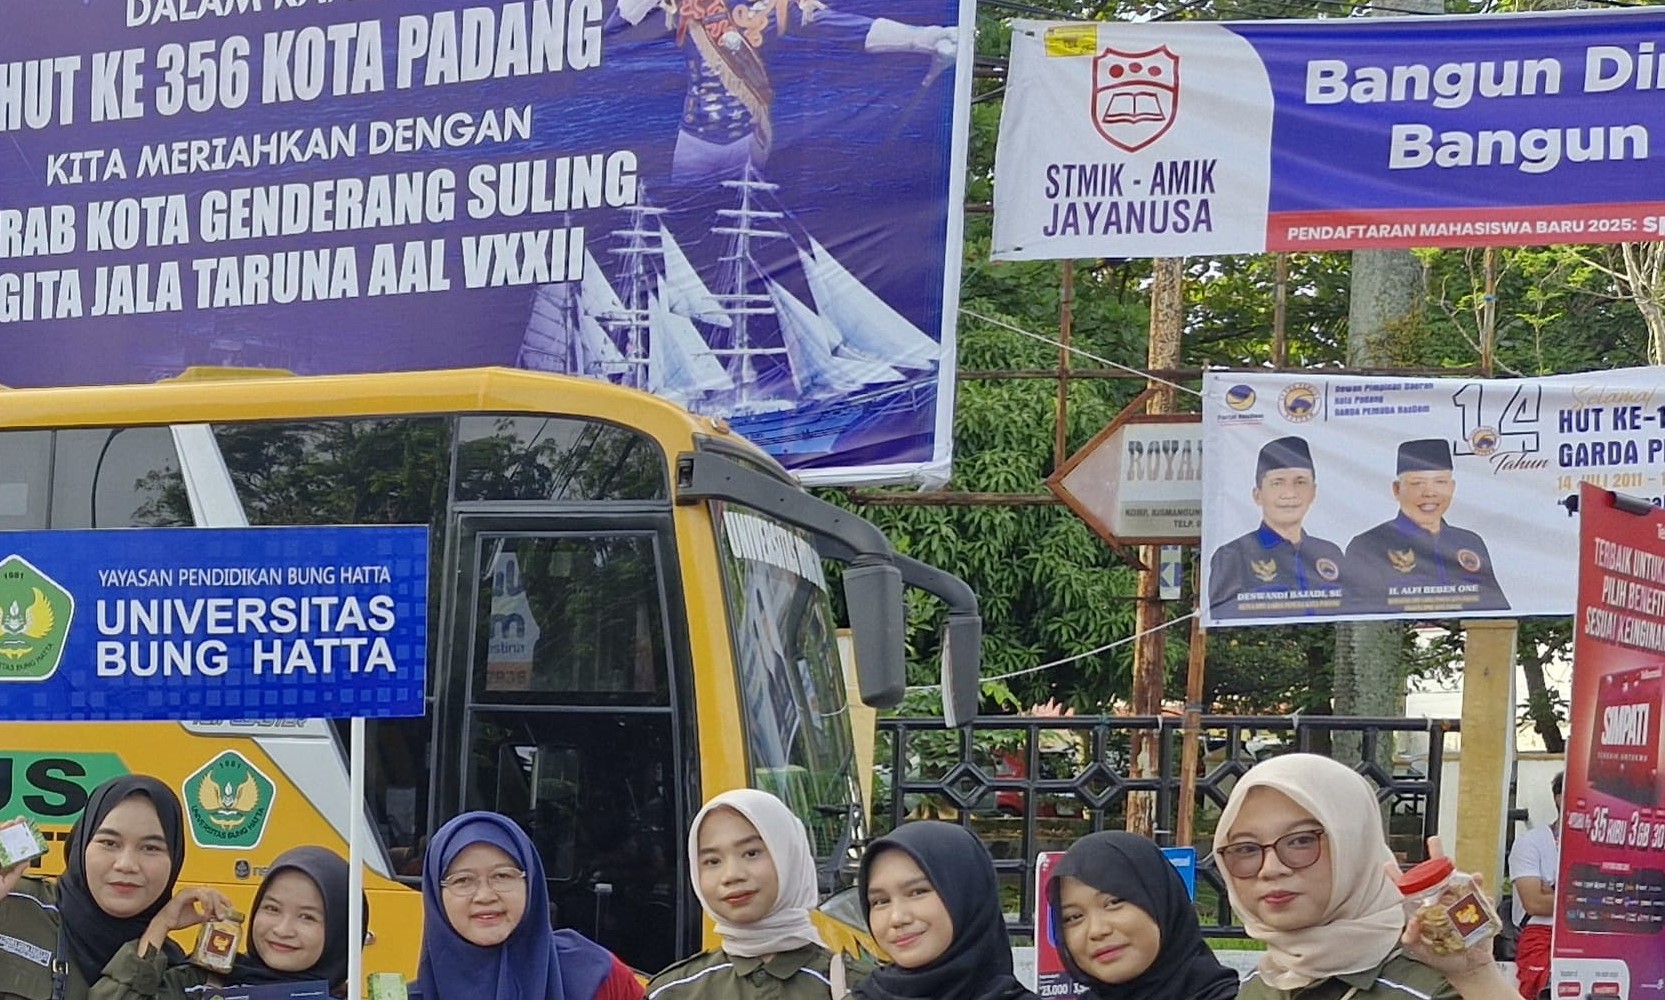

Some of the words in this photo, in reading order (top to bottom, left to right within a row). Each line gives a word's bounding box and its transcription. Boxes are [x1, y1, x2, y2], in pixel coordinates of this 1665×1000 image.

[90, 49, 145, 123] KE
[156, 35, 250, 116] 356
[262, 19, 384, 105] KOTA
[397, 0, 603, 89] PADANG
[1305, 55, 1561, 109] Bangun
[47, 148, 127, 186] KITA
[136, 124, 355, 178] MERIAHKAN
[369, 105, 532, 156] DENGAN
[1389, 124, 1649, 173] Bangun
[1045, 163, 1125, 200] STMIK
[1149, 159, 1216, 197] AMIK
[87, 194, 189, 252] KOTA
[200, 168, 456, 243] GENDERANG
[468, 150, 638, 220] SULING
[1043, 199, 1213, 237] JAYANUSA
[1288, 222, 1417, 241] PENDAFTARAN
[1419, 219, 1532, 238] MAHASISWA
[1536, 218, 1584, 236] BARU
[1587, 216, 1637, 233] 2025:
[91, 263, 184, 316] JALA
[193, 242, 358, 308] TARUNA
[368, 239, 451, 297] AAL
[461, 227, 585, 289] VXXII
[1335, 384, 1362, 393] Dewan
[1364, 383, 1402, 392] Pimpinan
[1355, 395, 1384, 404] Padang
[1362, 406, 1396, 416] PEMUDA
[1452, 383, 1542, 456] 14
[1559, 408, 1604, 433] HUT
[1489, 451, 1549, 475] Tahun
[1558, 439, 1639, 468] GARDA
[1557, 475, 1572, 490] 14
[1613, 472, 1642, 487] 2011
[1594, 537, 1633, 574] TERBAIK
[98, 569, 173, 587] YAYASAN
[179, 568, 283, 586] PENDIDIKAN
[287, 567, 336, 585] BUNG
[340, 566, 391, 584] HATTA
[1458, 584, 1479, 592] ONE
[1602, 575, 1628, 608] PILIH
[96, 595, 396, 635] UNIVERSITAS
[1585, 606, 1618, 639] SESUAI
[96, 639, 229, 678] BUNG
[253, 636, 397, 675] HATTA
[1601, 703, 1650, 746] SIMPATI
[191, 805, 227, 840] UNIVERSITAS
[247, 806, 266, 830] HATTA
[1591, 807, 1608, 843] 35
[1607, 819, 1627, 846] RIBU
[1628, 810, 1639, 845] 3
[1637, 821, 1650, 848] GB
